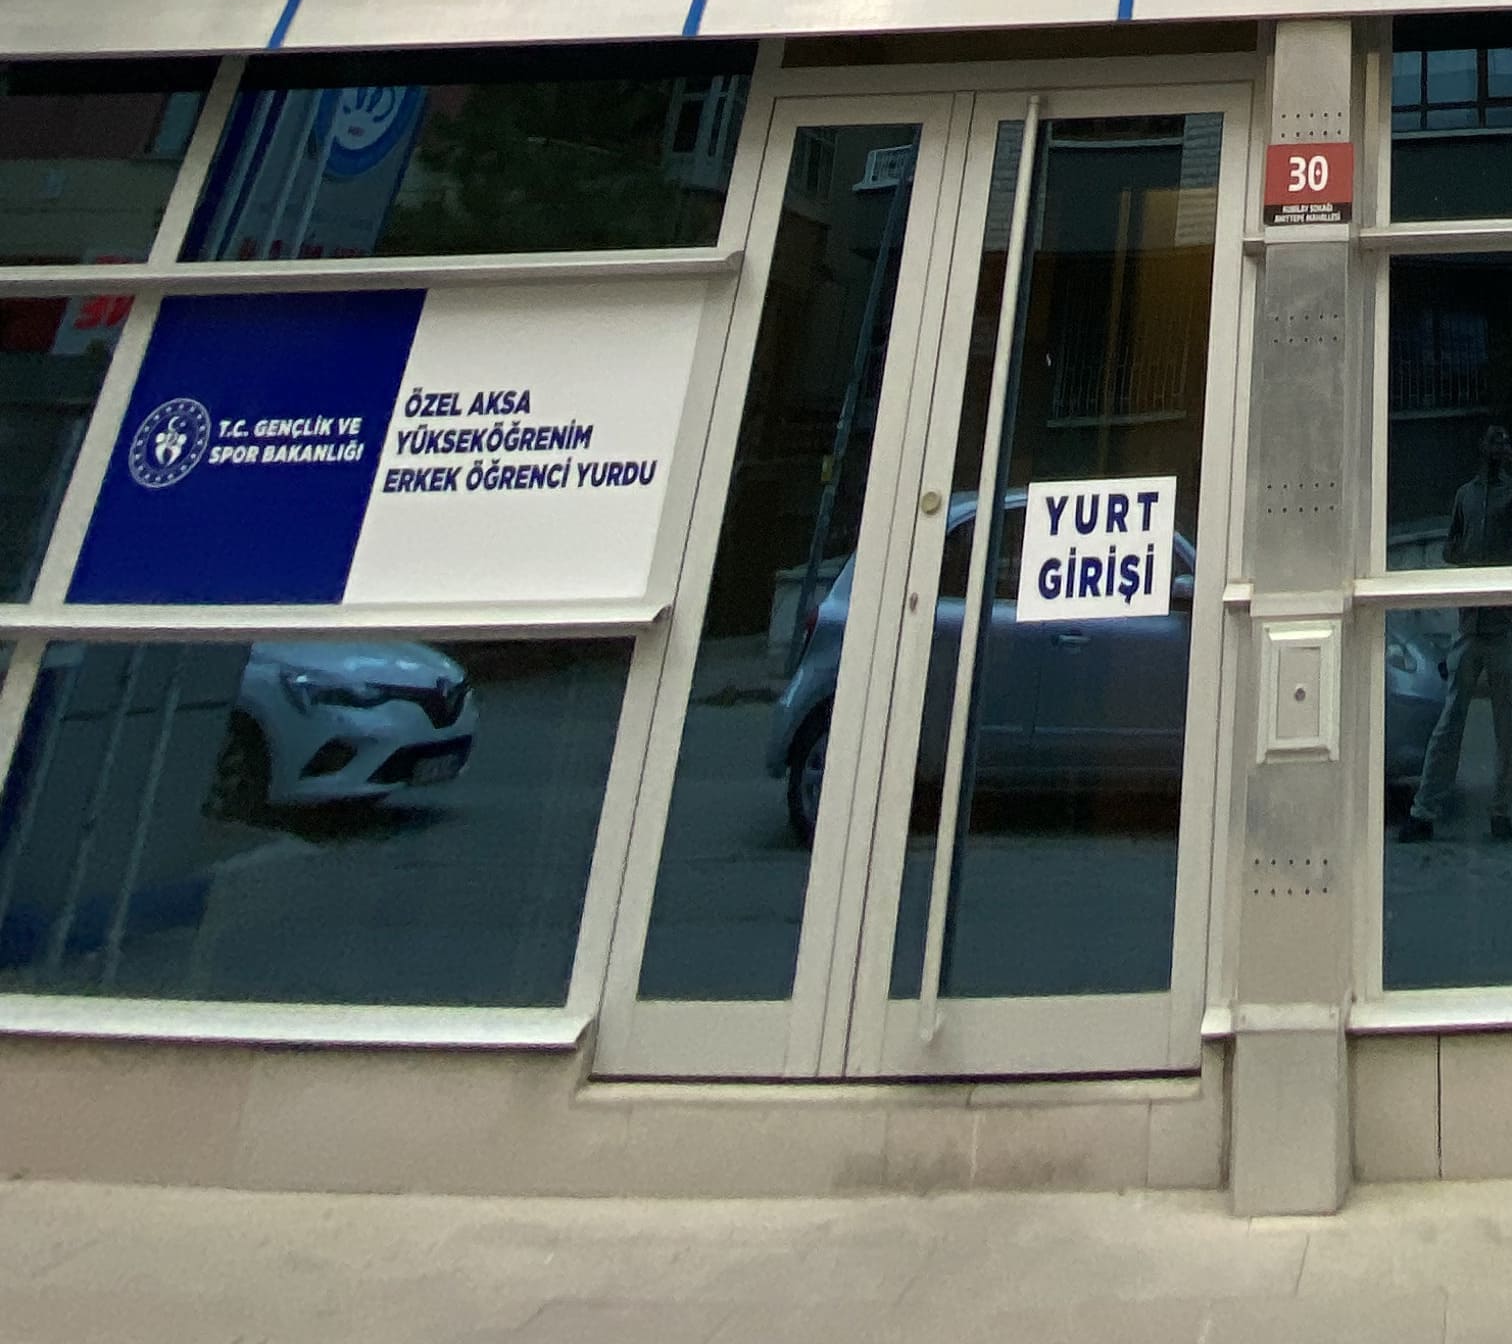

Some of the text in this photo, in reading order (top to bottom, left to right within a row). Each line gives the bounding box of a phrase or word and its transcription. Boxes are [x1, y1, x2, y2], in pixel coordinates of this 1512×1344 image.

[1287, 155, 1329, 192] 30
[404, 387, 531, 418] ÖZEL AKSA
[218, 414, 363, 440] T.C. GENÇLİK VE
[396, 419, 594, 456] YÜKSEKÖĞRENİM
[208, 439, 365, 464] SPOR BAKANLIĞI
[382, 456, 658, 494] ERKEK ÖĞRENCİ YURDU
[1045, 491, 1160, 537] YURT
[1037, 543, 1155, 605] GİRİŞİ
